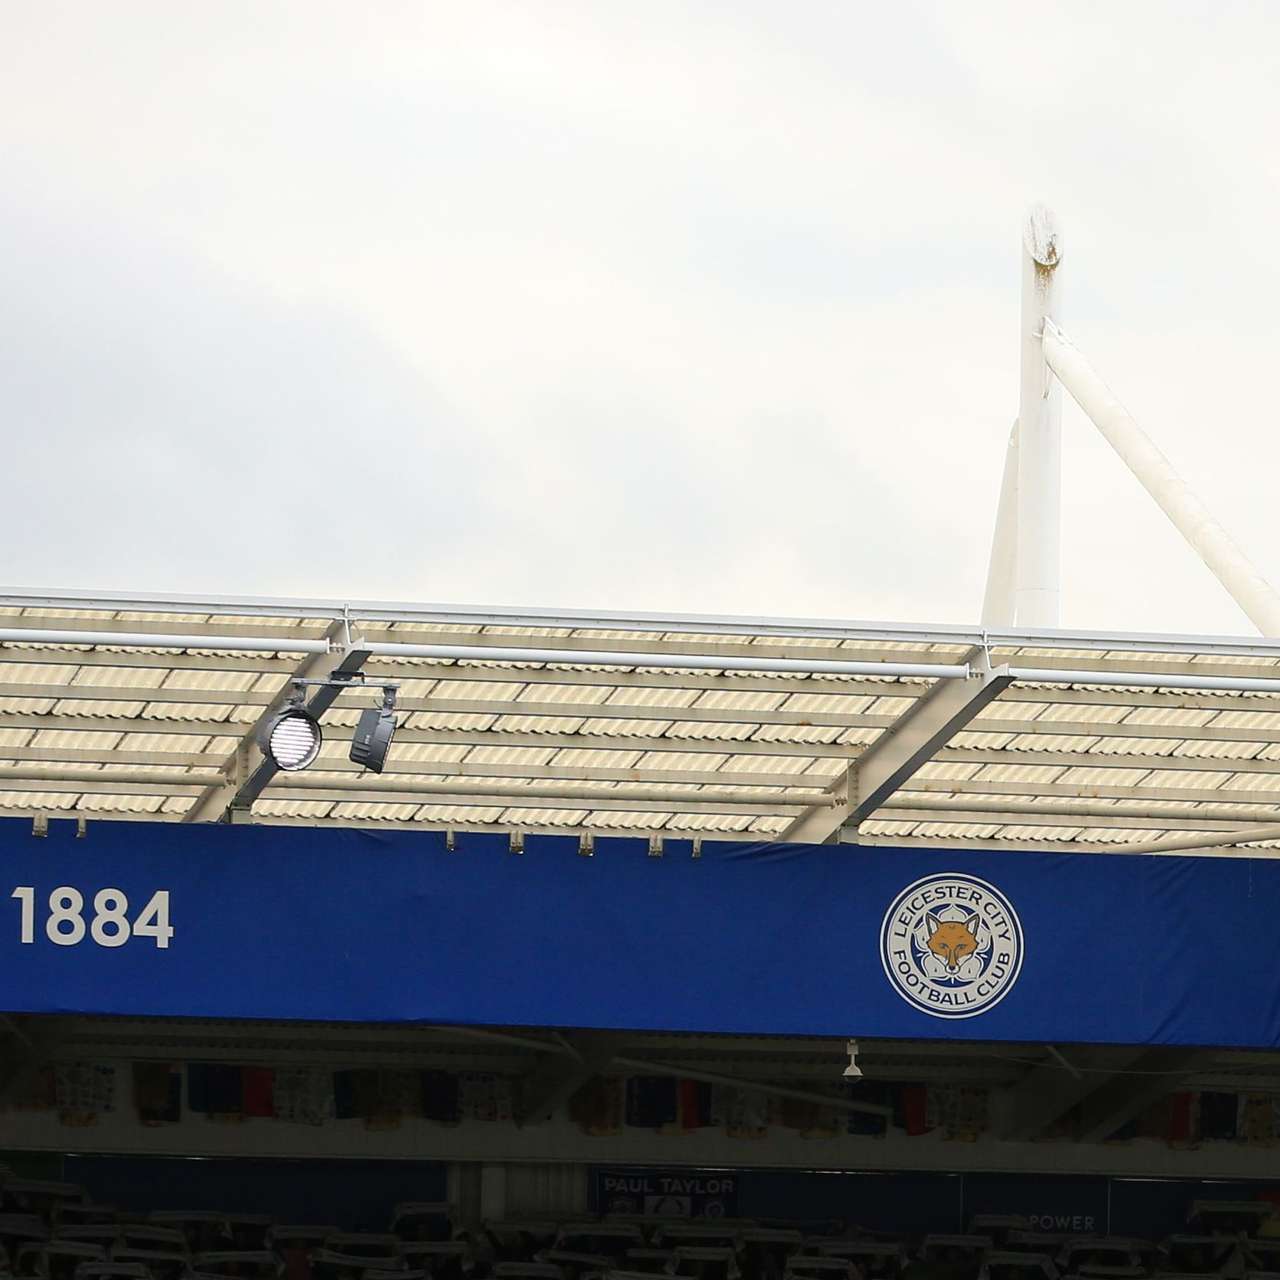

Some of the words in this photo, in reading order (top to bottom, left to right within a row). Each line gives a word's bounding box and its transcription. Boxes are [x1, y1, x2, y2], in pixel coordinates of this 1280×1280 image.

[11, 886, 174, 949] 1884
[894, 885, 983, 939] LEICESTER
[984, 902, 1011, 942] CITY
[893, 950, 977, 1006] FOOTBALL
[976, 951, 1011, 997] CLUB
[605, 1178, 654, 1192] PAUL
[661, 1179, 735, 1194] TAYLOR
[1029, 1216, 1097, 1231] POWER
